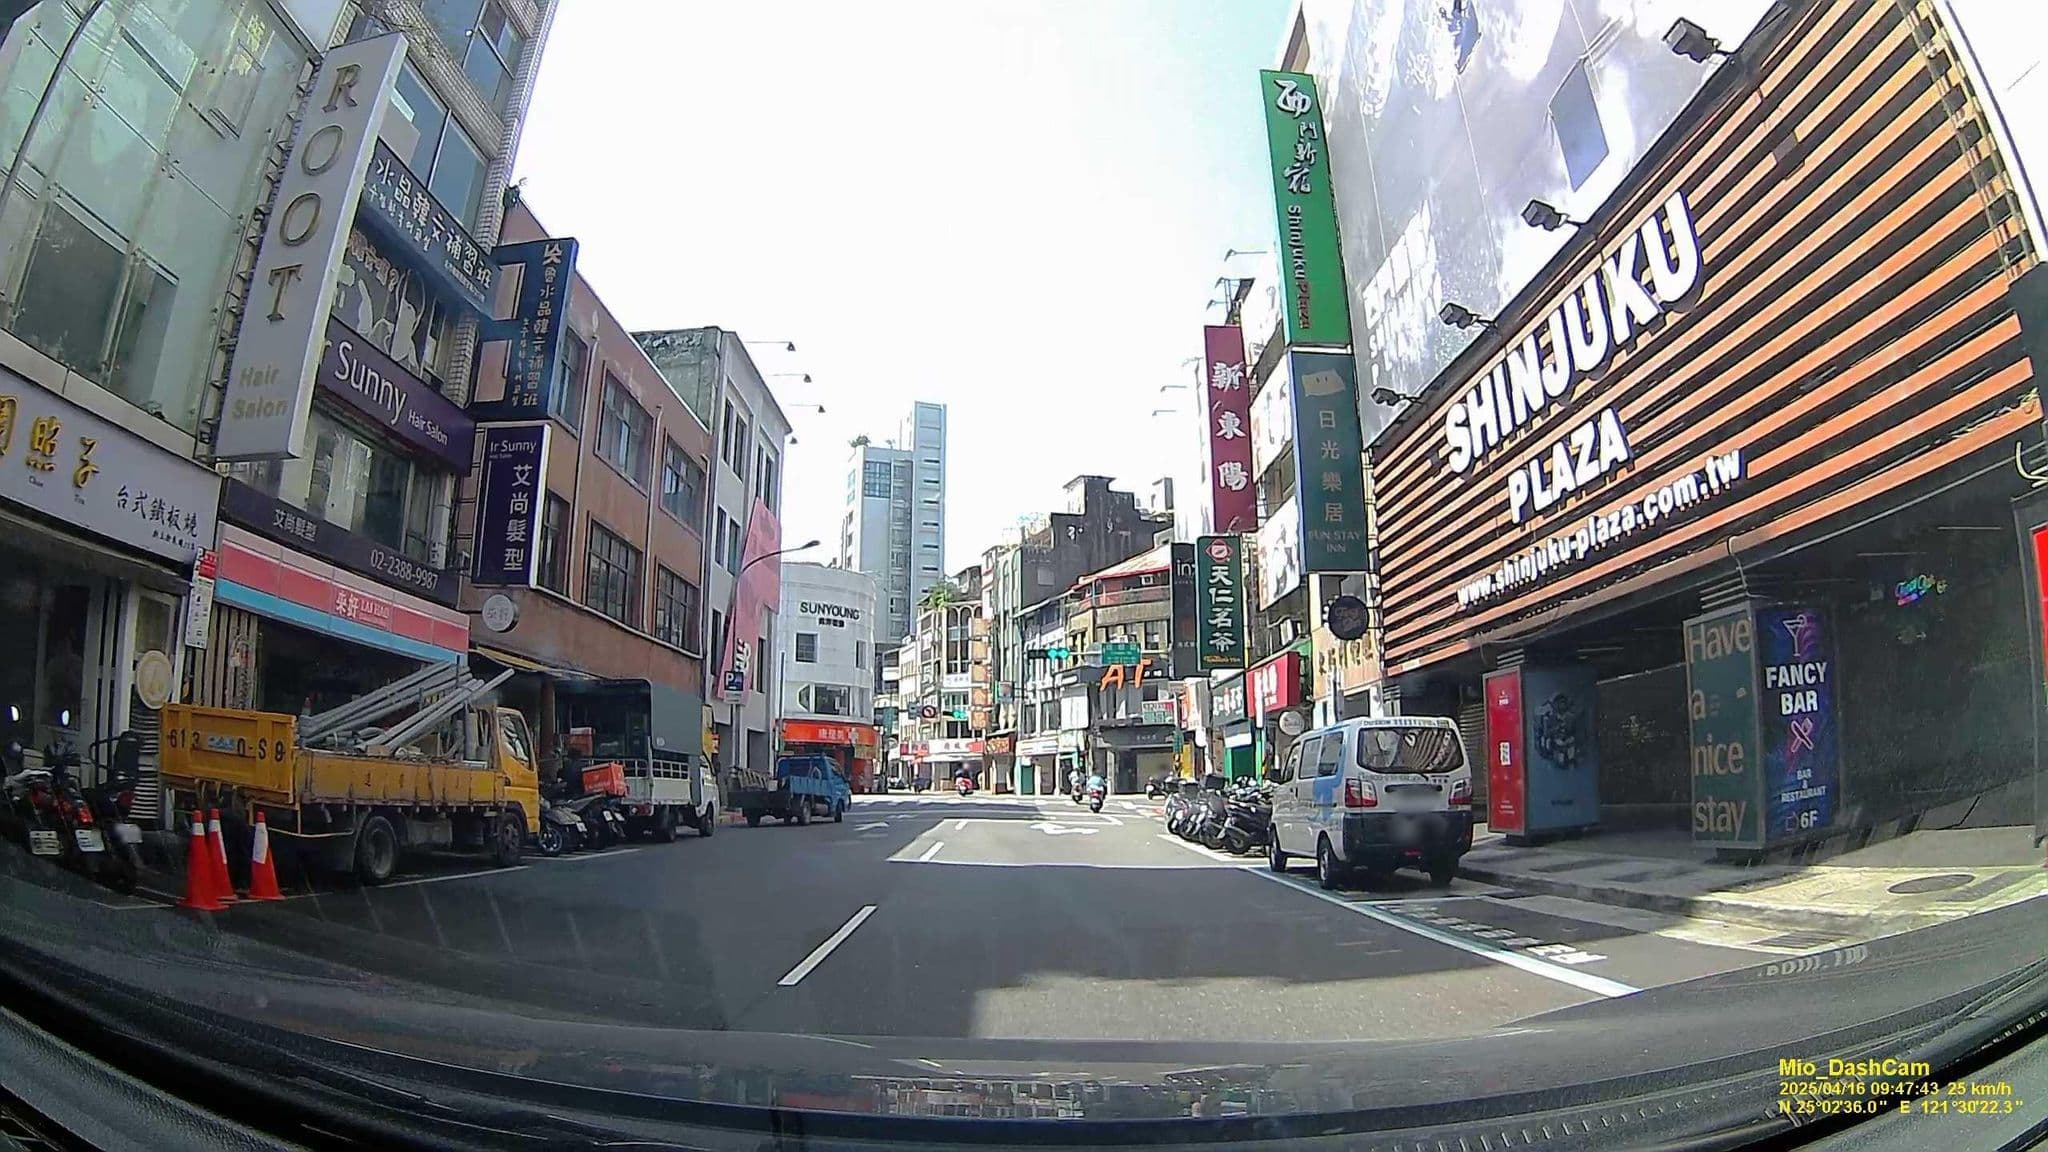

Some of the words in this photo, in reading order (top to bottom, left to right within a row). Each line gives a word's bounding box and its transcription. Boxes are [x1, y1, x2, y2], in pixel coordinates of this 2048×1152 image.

[267, 63, 361, 323] ROOT
[1445, 191, 1702, 474] SHINJUKU
[232, 398, 288, 420] Salon
[334, 340, 407, 426] Sunny
[408, 409, 426, 431] Hair
[427, 421, 448, 446] Salon
[501, 440, 537, 454] Sunny
[1211, 361, 1249, 491] 新東陽
[1319, 410, 1344, 523] 日光樂居
[1507, 407, 1630, 524] PLAZA
[116, 485, 198, 538] 台式鐵板燒
[503, 463, 533, 571] 艾尚髮型
[1457, 448, 1743, 607] www.shinjuku-plaza.com.tw
[1326, 543, 1346, 554] INN
[371, 549, 439, 591] 02-2388-9987
[800, 602, 860, 620] SUNYOUNG
[1688, 618, 1751, 664] Have
[1766, 662, 1827, 689] FANCY
[1691, 689, 1706, 721] a
[1780, 691, 1819, 715] BAR
[1694, 733, 1745, 776] nice
[1796, 768, 1812, 781] BAR
[1695, 798, 1746, 840] stay
[1800, 811, 1819, 829] 6F
